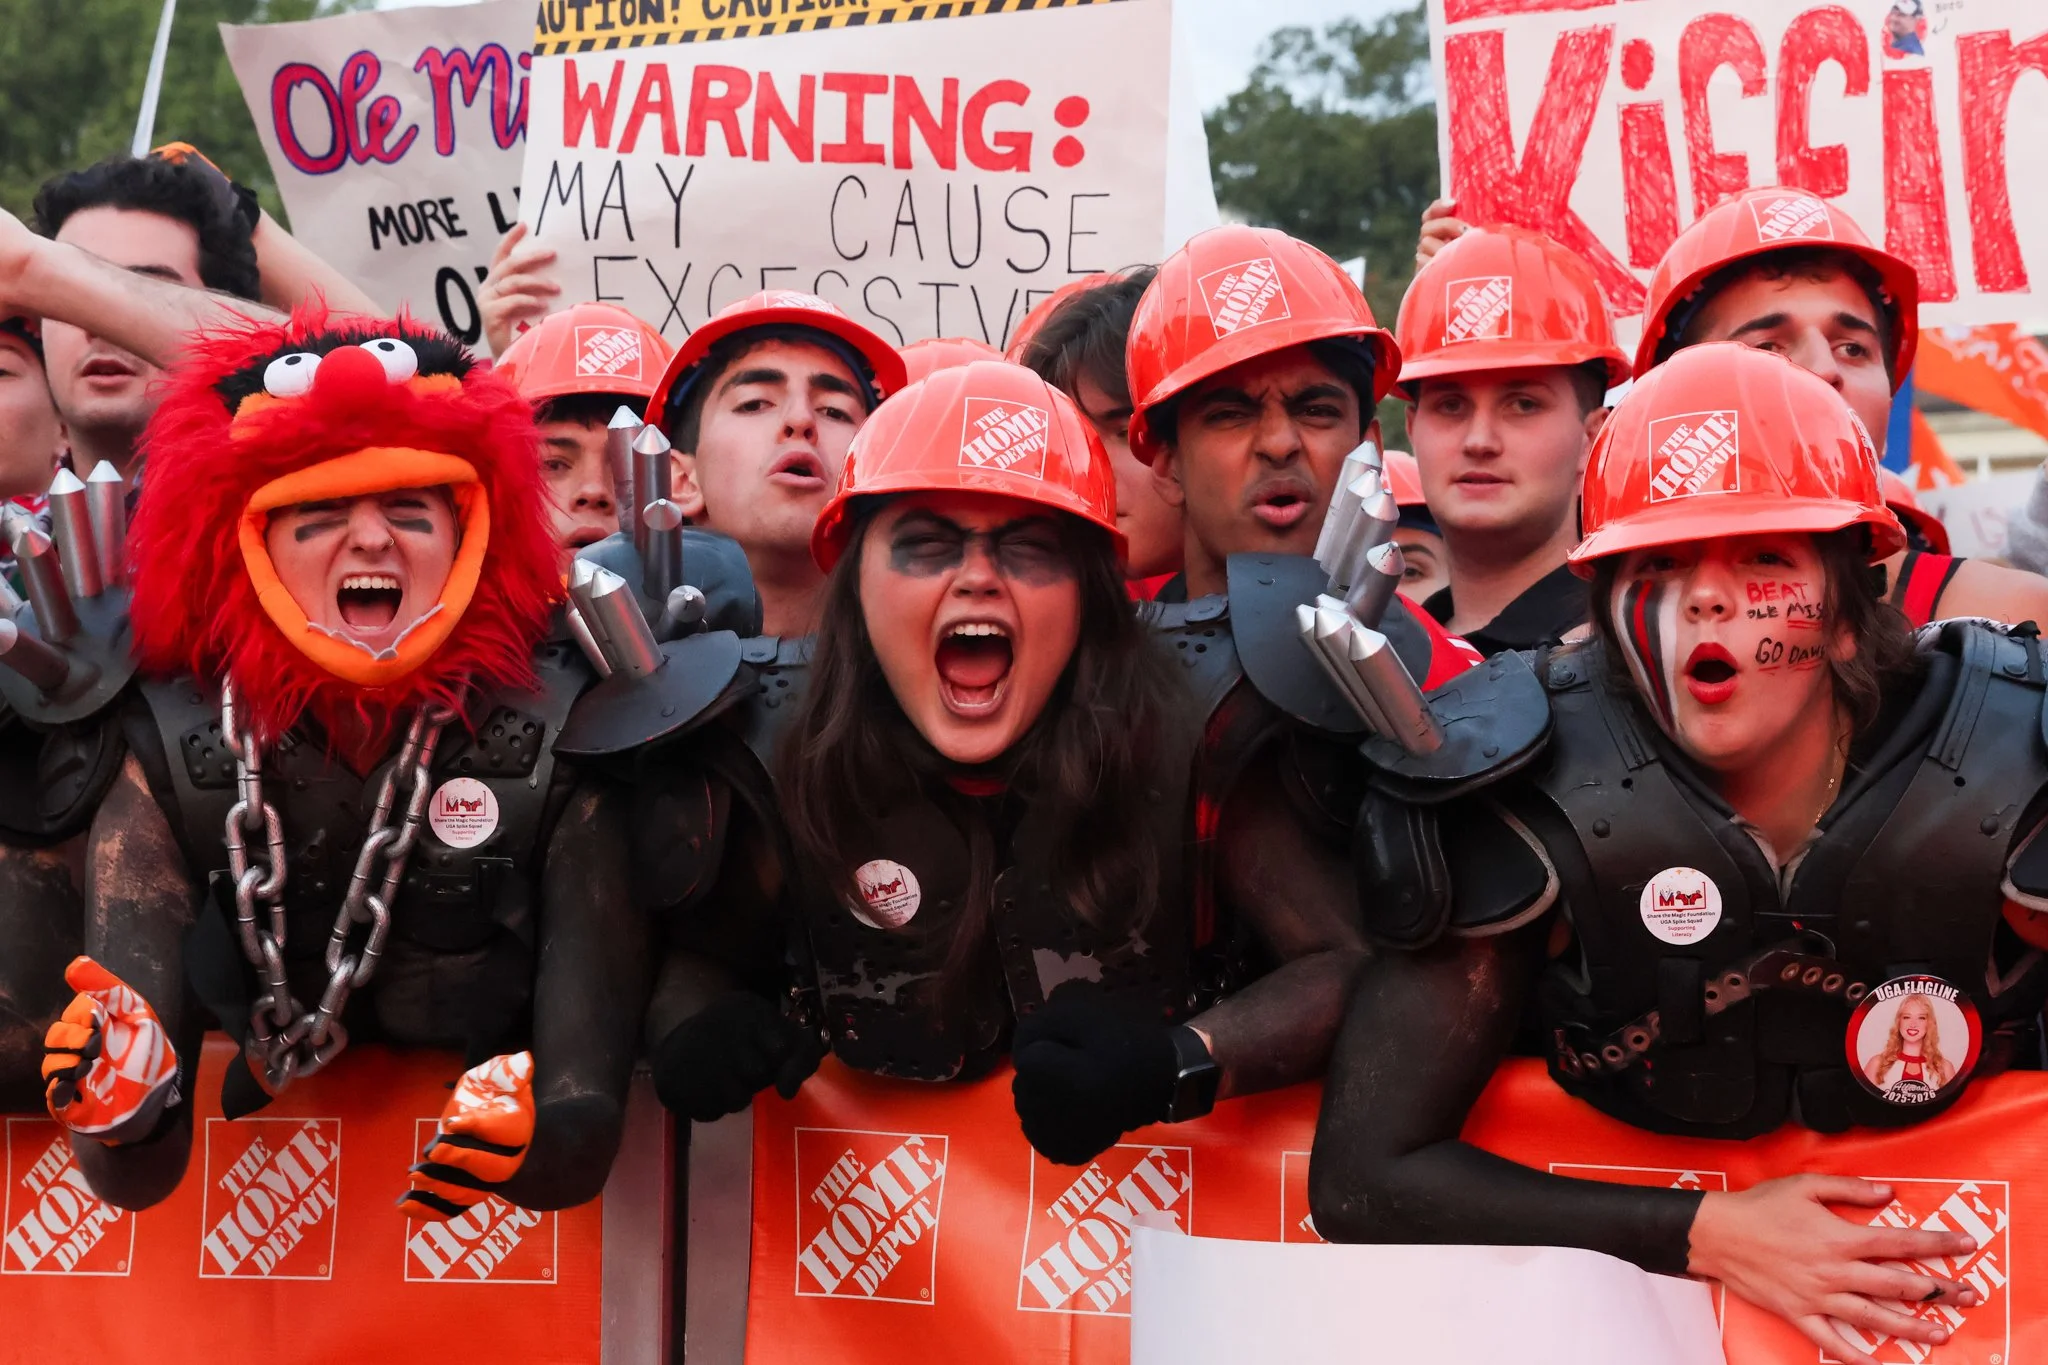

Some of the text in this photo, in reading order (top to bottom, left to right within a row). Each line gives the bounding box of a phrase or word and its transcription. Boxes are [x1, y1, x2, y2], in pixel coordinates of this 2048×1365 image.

[537, 0, 680, 35] AUTION!
[271, 50, 419, 175] Ole
[562, 59, 1091, 173] WARNING:
[368, 197, 467, 250] MORE
[535, 159, 1110, 275] MAY CAUSE
[1213, 273, 1239, 300] THE
[1214, 259, 1275, 331] HOME
[1243, 279, 1280, 324] DEPOT
[1448, 278, 1510, 339] HOME
[1470, 298, 1509, 337] DEPOT
[578, 329, 640, 374] HOME
[961, 406, 1047, 465] HOME
[973, 406, 1010, 431] THE
[1658, 423, 1693, 457] THE
[993, 433, 1046, 470] DEPOT
[1651, 412, 1736, 497] HOME
[1683, 439, 1737, 494] DEPOT
[1746, 581, 1808, 604] BEAT
[1747, 605, 1780, 619] OLE
[1755, 637, 1784, 664] GO
[1875, 981, 1960, 1002] UGA FLAGLINE
[1882, 1089, 1936, 1103] 2025-2026
[21, 1135, 75, 1197] THE
[218, 1135, 272, 1198] THE
[810, 1148, 867, 1214] THE
[1046, 1161, 1114, 1229] THE
[203, 1119, 340, 1276] HOME
[250, 1177, 337, 1277] DEPOT
[799, 1135, 946, 1296] HOME
[1023, 1146, 1191, 1310] HOME
[53, 1200, 122, 1272] DEPO
[464, 1203, 542, 1280] DEPO
[852, 1195, 937, 1297] DEPOT
